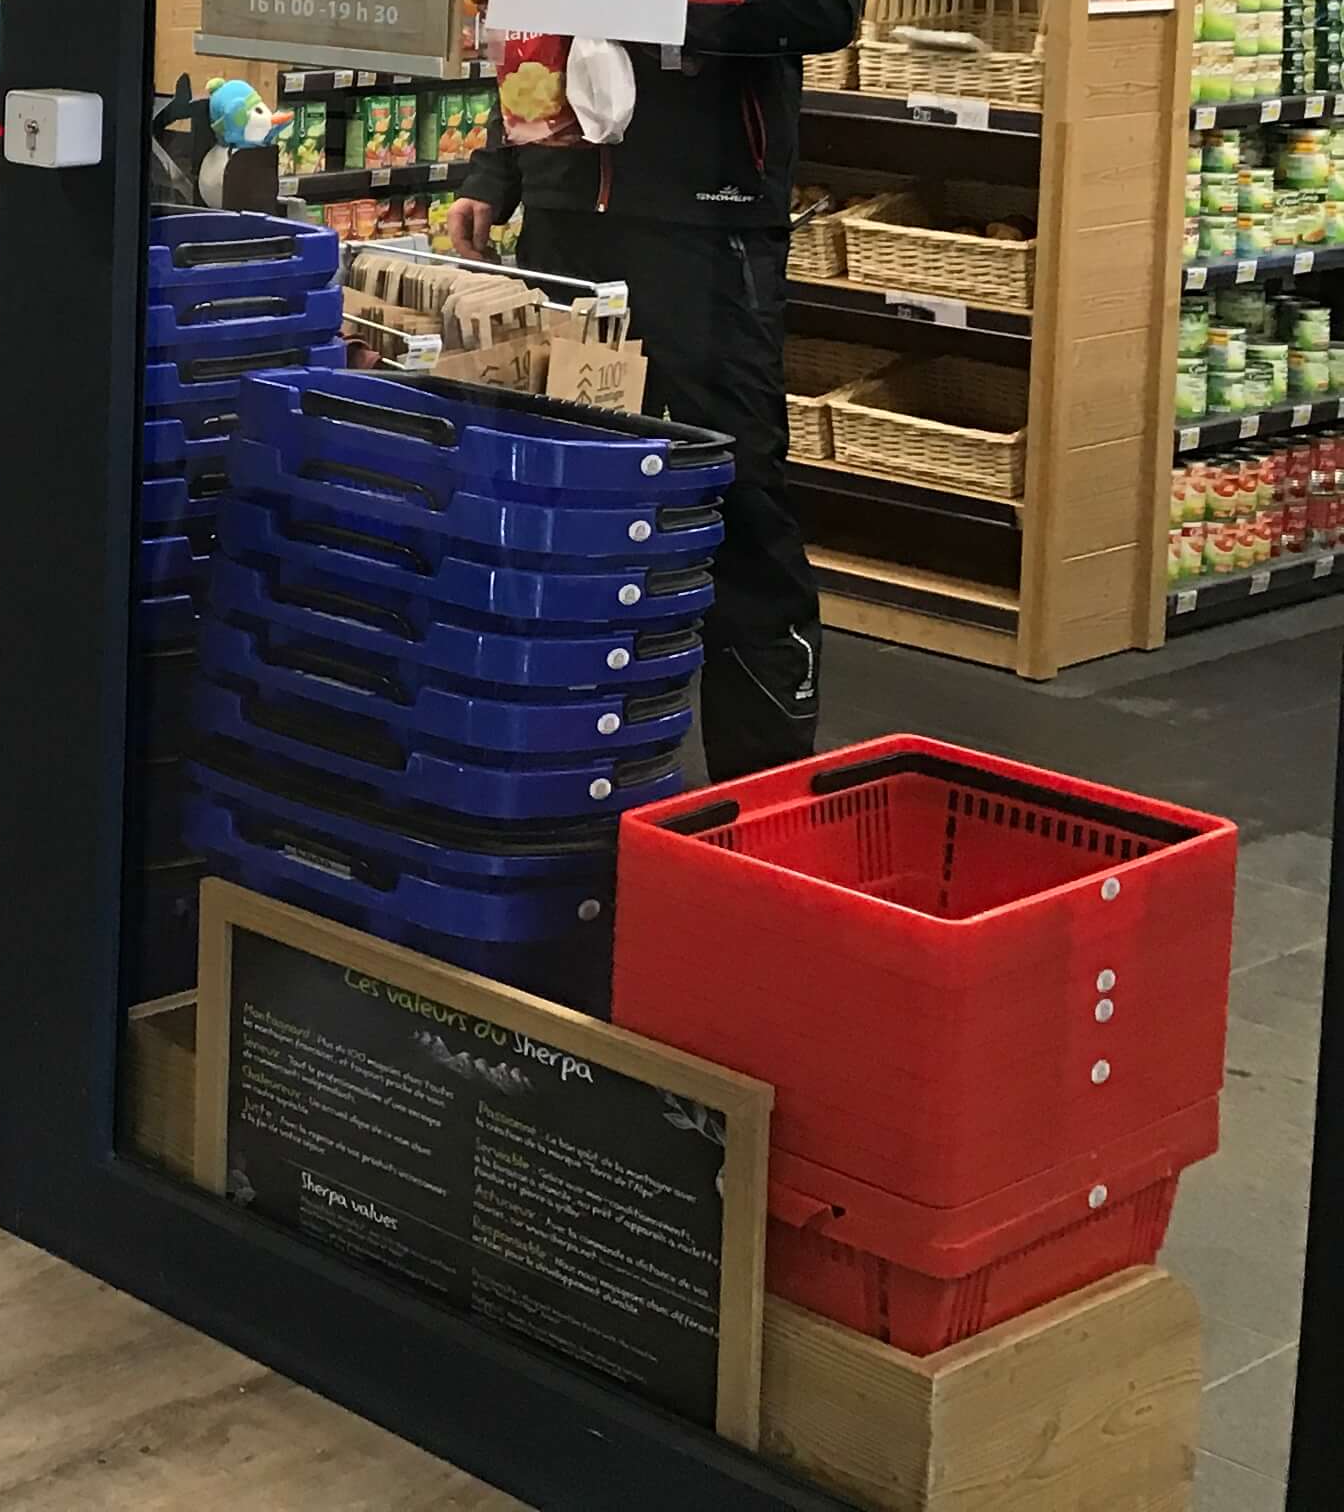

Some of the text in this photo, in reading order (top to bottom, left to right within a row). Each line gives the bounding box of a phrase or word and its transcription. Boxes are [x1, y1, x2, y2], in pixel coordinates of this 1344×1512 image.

[356, 2, 367, 22] h
[374, 5, 398, 24] 30
[344, 968, 379, 998] Les
[386, 988, 467, 1031] valeurs
[474, 1020, 507, 1046] du
[351, 1200, 398, 1230] values
